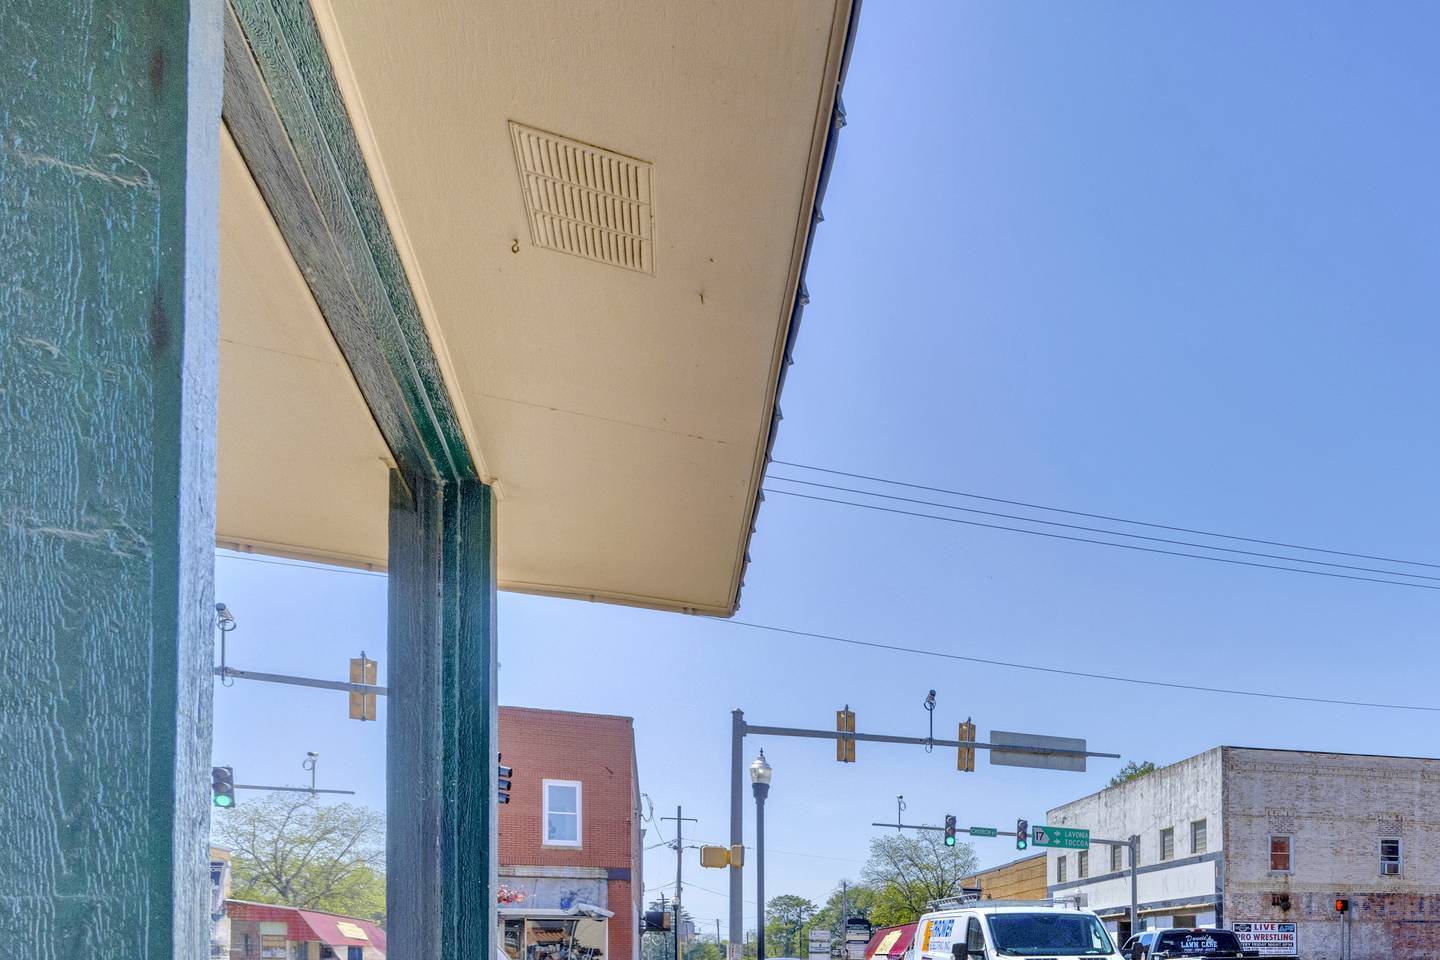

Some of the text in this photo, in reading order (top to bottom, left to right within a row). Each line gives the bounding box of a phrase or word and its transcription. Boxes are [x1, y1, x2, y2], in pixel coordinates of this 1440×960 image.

[1036, 831, 1045, 841] 17
[1064, 831, 1088, 839] LAVONIA
[1064, 839, 1088, 847] TOCCOA
[1236, 933, 1294, 941] PRO WRESTLING
